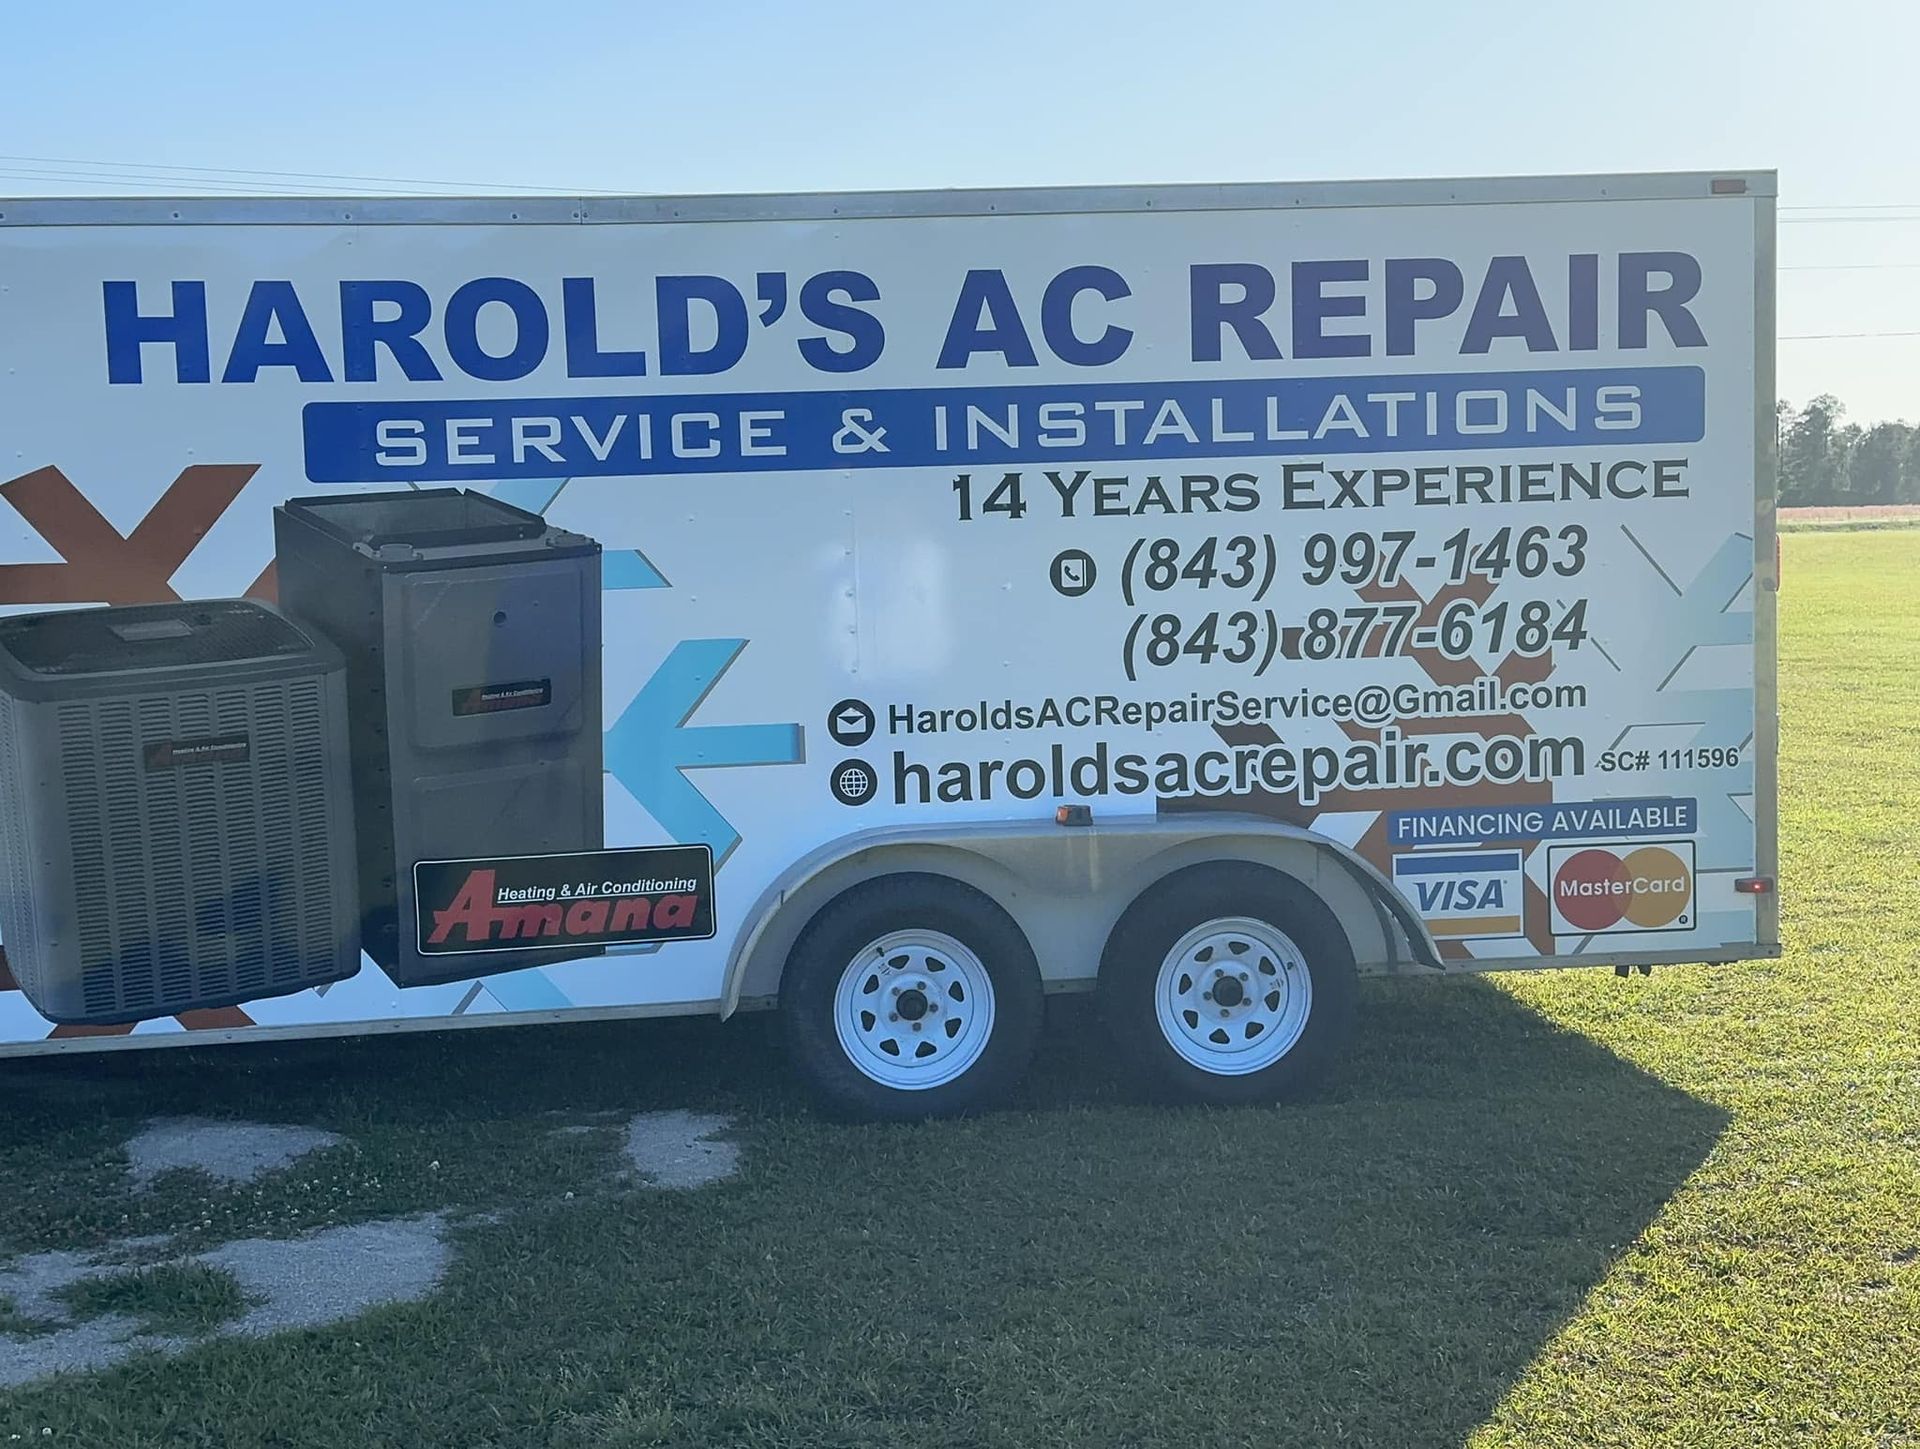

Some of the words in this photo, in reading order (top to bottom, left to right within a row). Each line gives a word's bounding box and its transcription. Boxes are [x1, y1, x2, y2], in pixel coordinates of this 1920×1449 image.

[101, 270, 886, 386] HAROLD'S
[935, 264, 1136, 370] AC
[1189, 251, 1709, 364] REPAIR
[374, 408, 788, 468] SERVICE
[830, 406, 892, 455] &
[933, 384, 1644, 452] INSTALLATIONS
[952, 472, 1027, 521] 14
[1041, 470, 1262, 519] YEARS
[1281, 457, 1691, 511] EXPERIENCE
[1119, 537, 1278, 606] (843)
[1301, 524, 1589, 588] 997-1463
[1121, 612, 1280, 681] (843)
[1303, 598, 1591, 664] 877-6184
[888, 680, 1588, 735] HaroldsACRepairService@Gmail.com
[893, 731, 1586, 804] haroldsacrepair.com
[1600, 749, 1650, 773] SC#
[1659, 746, 1740, 771] 111596
[1398, 812, 1544, 839] FINANCING
[1551, 805, 1688, 832] AVAILABLE
[427, 869, 698, 944] Amana
[497, 884, 557, 903] Heating
[560, 883, 572, 897] &
[575, 881, 600, 896] Air
[602, 877, 698, 894] Conditioning
[1414, 879, 1504, 911] VISA
[1559, 874, 1687, 898] MasterCard
